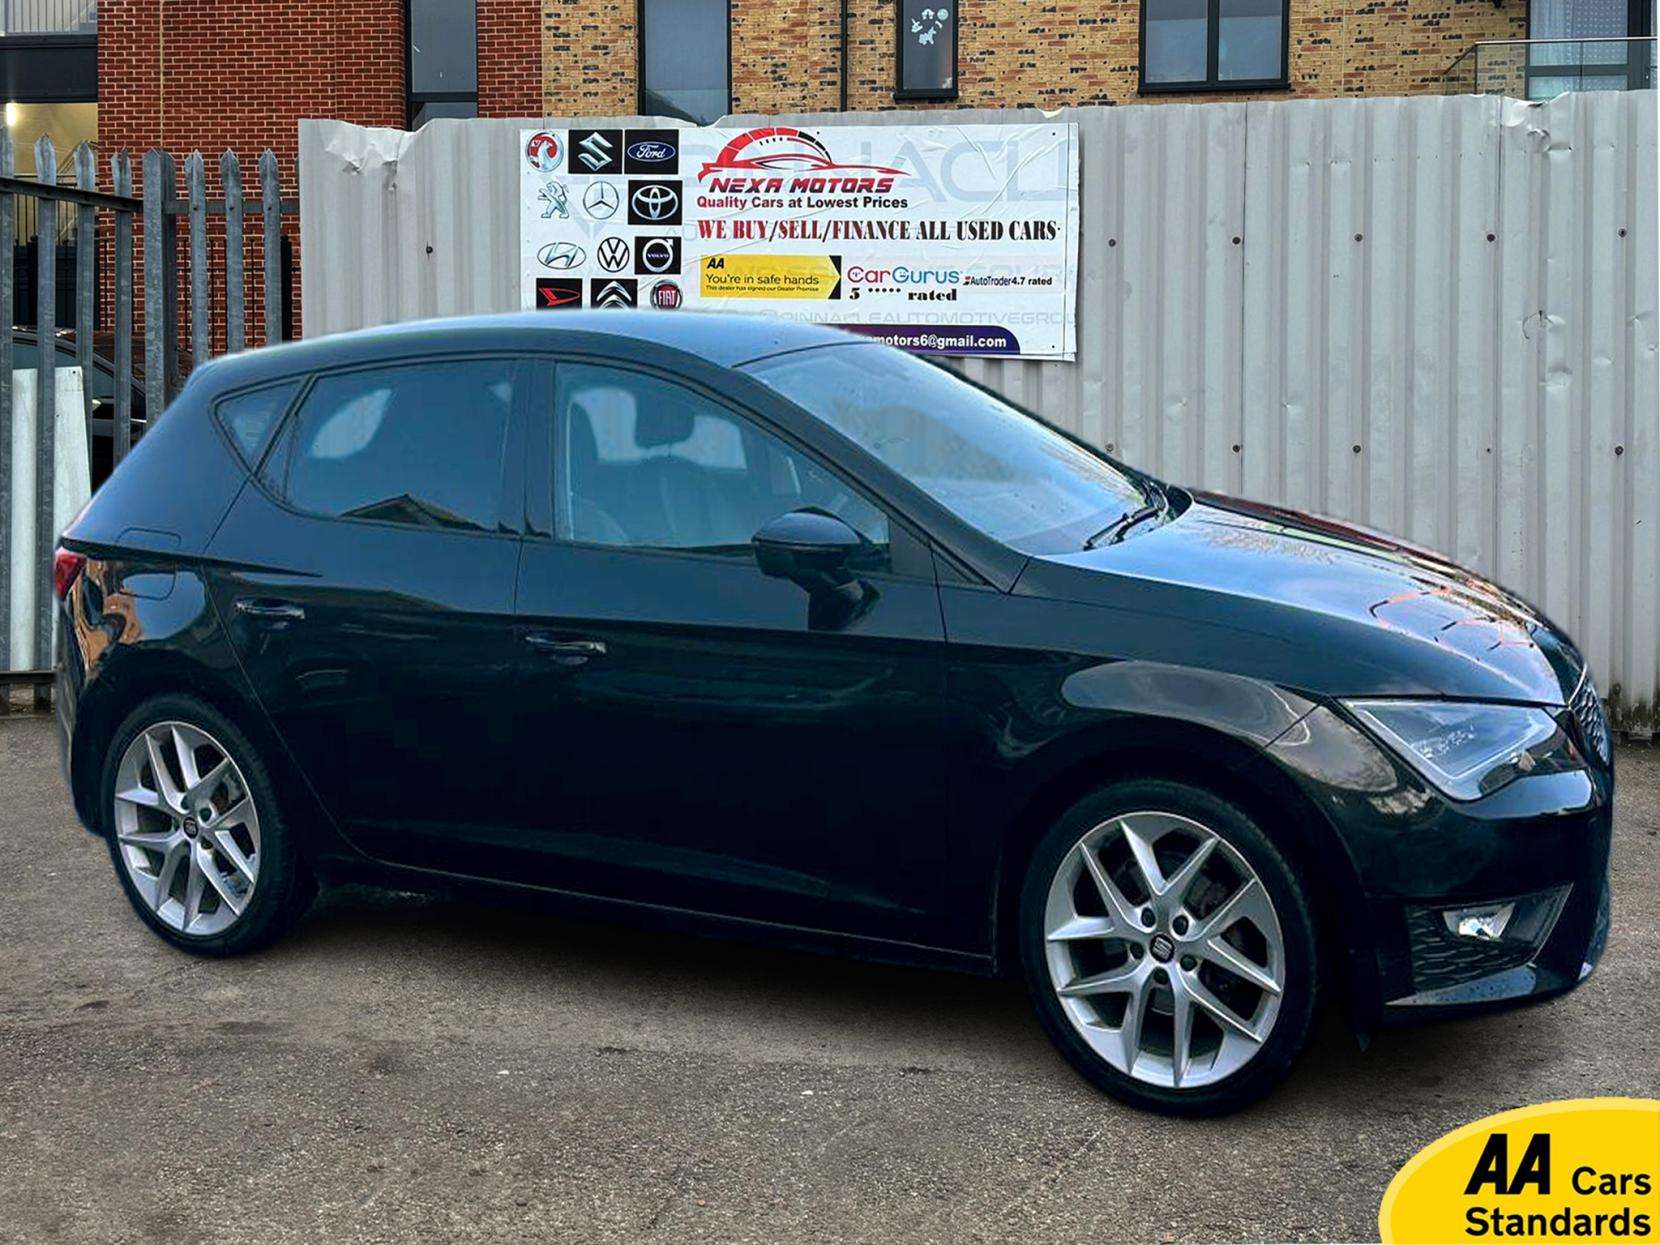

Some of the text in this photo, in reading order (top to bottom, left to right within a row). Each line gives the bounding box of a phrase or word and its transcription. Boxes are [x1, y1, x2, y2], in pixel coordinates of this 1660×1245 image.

[636, 145, 666, 158] Ford
[709, 178, 894, 194] NEXA MOTORS
[697, 196, 908, 211] Quality Cars at Lowest Prices
[697, 220, 726, 240] WE
[916, 220, 950, 240] ALL
[956, 220, 1003, 240] USED
[1009, 220, 1057, 240] CARS
[707, 258, 725, 269] AA
[706, 273, 819, 285] You're in safe hands
[1027, 276, 1053, 286] rated
[658, 290, 676, 306] FIAT
[849, 287, 957, 301] 5 rated
